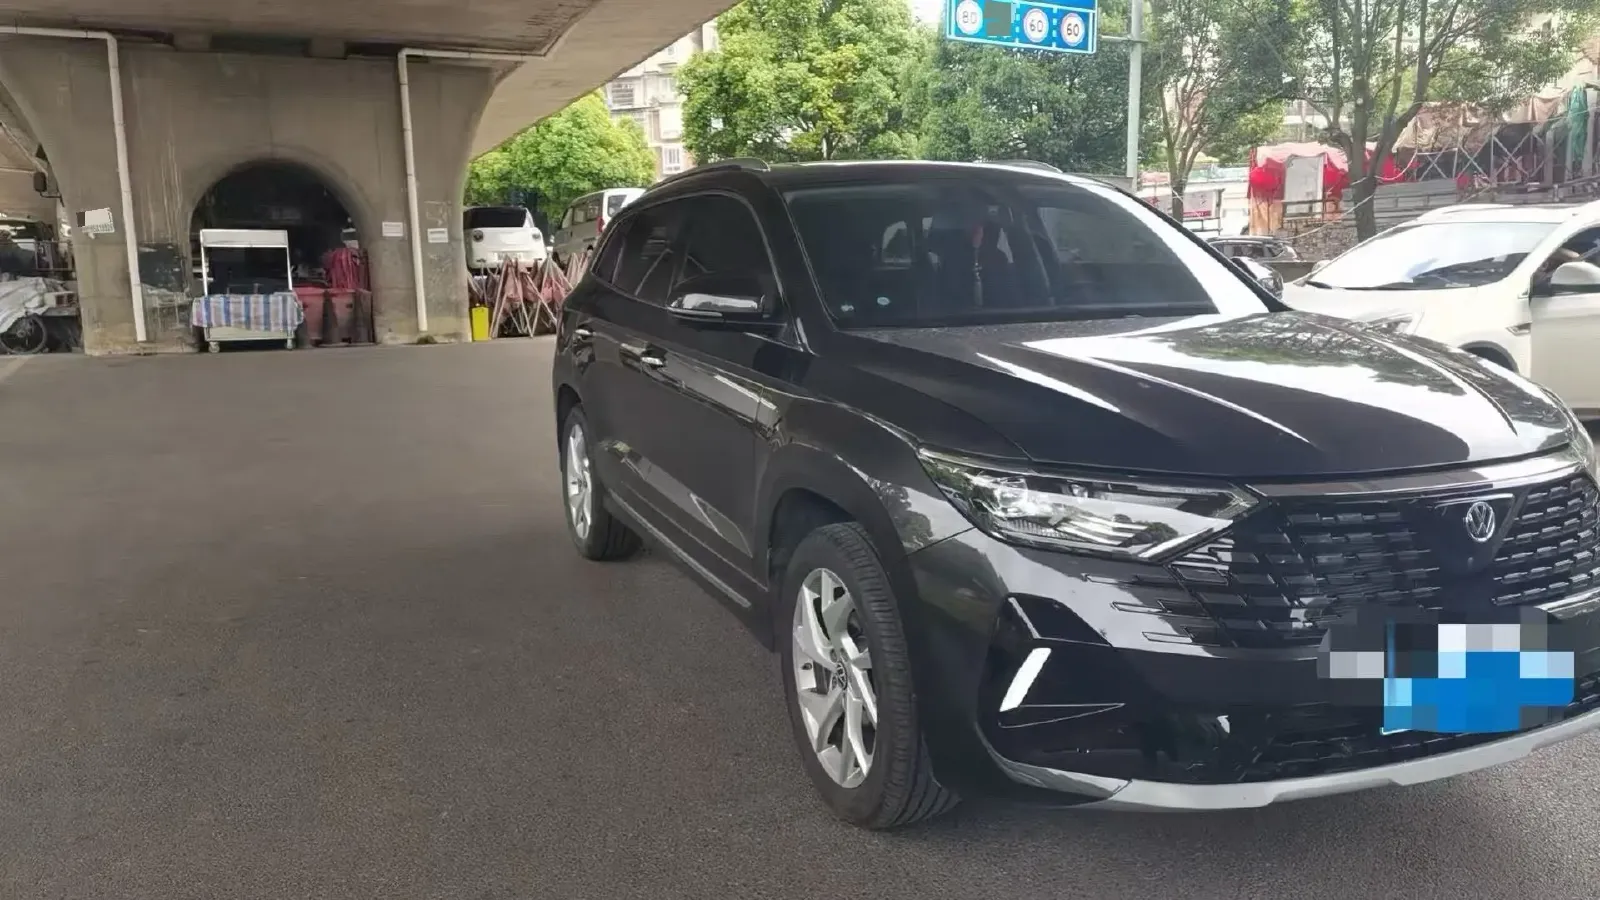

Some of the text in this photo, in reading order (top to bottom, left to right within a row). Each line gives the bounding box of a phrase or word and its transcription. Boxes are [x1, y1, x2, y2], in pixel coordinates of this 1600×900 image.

[962, 11, 977, 24] 80
[1030, 19, 1043, 32] 60
[1067, 23, 1079, 37] 60
